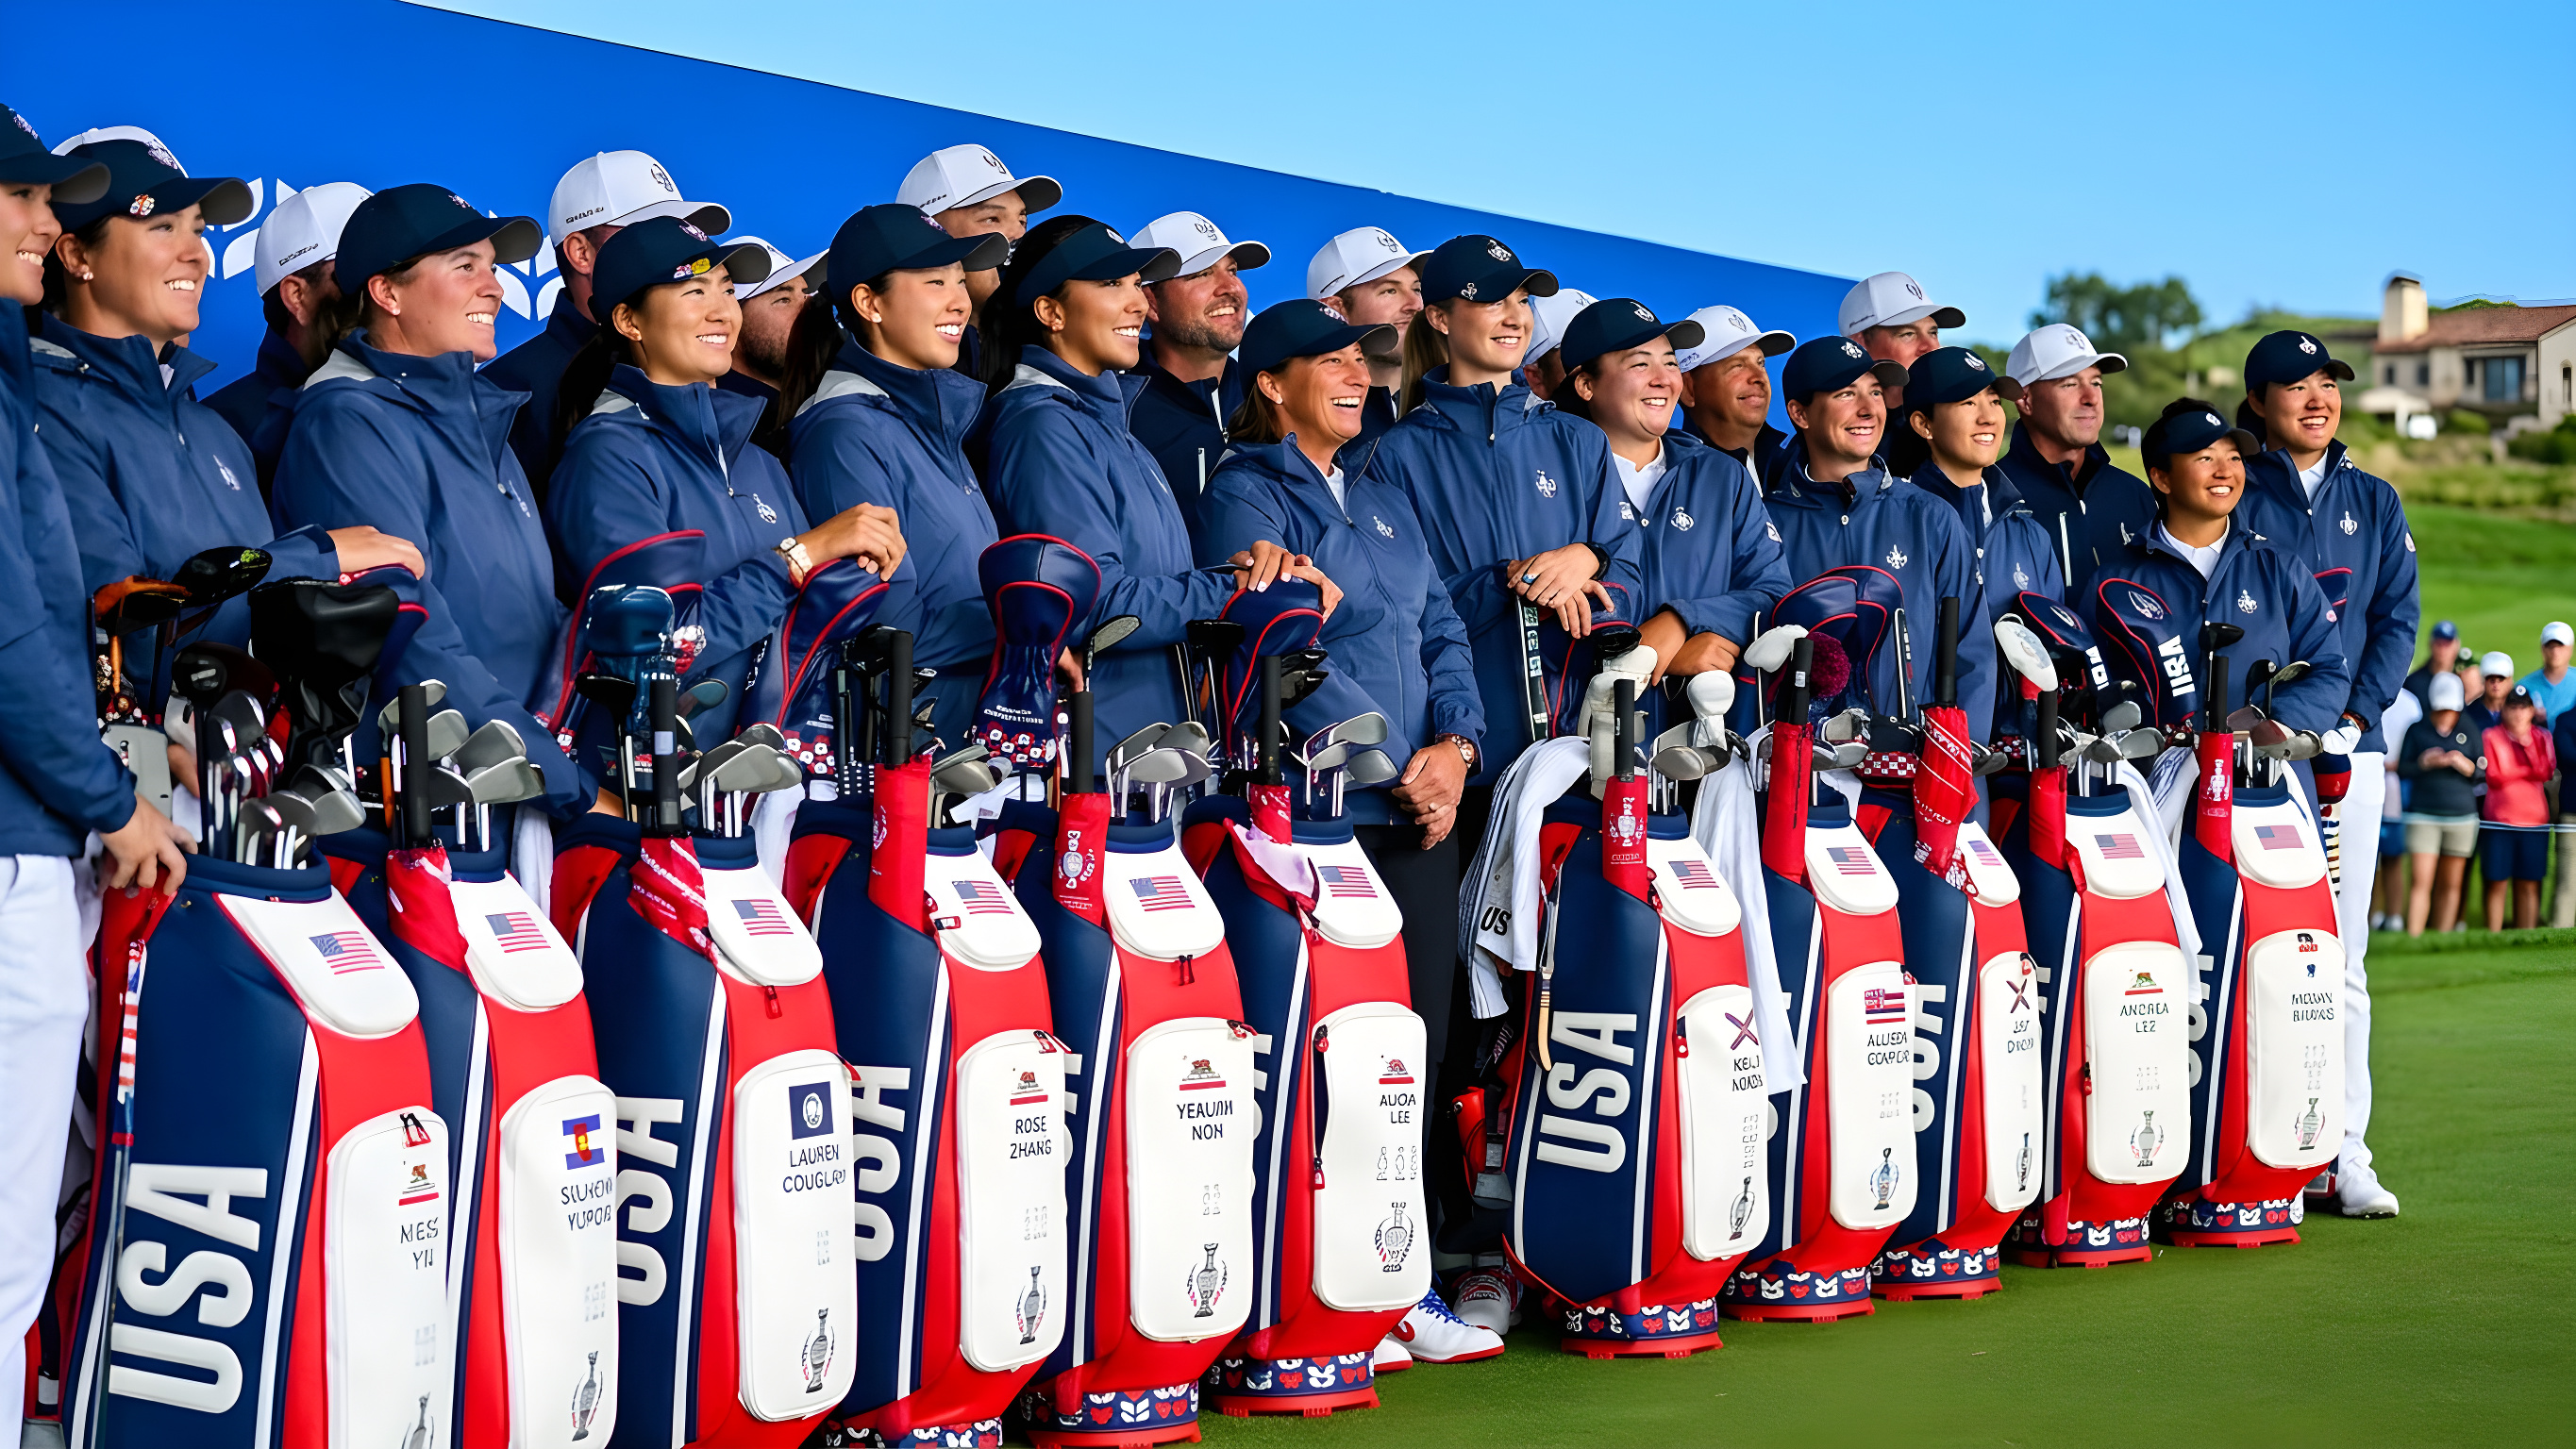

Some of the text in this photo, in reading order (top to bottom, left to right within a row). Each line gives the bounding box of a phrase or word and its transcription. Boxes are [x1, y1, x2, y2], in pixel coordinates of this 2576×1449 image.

[1537, 1011, 1637, 1173] USA
[1015, 1115, 1046, 1134] ROSE
[1391, 1111, 1410, 1124] LEE
[790, 1144, 839, 1168] LAUREN
[109, 1163, 268, 1414] USA
